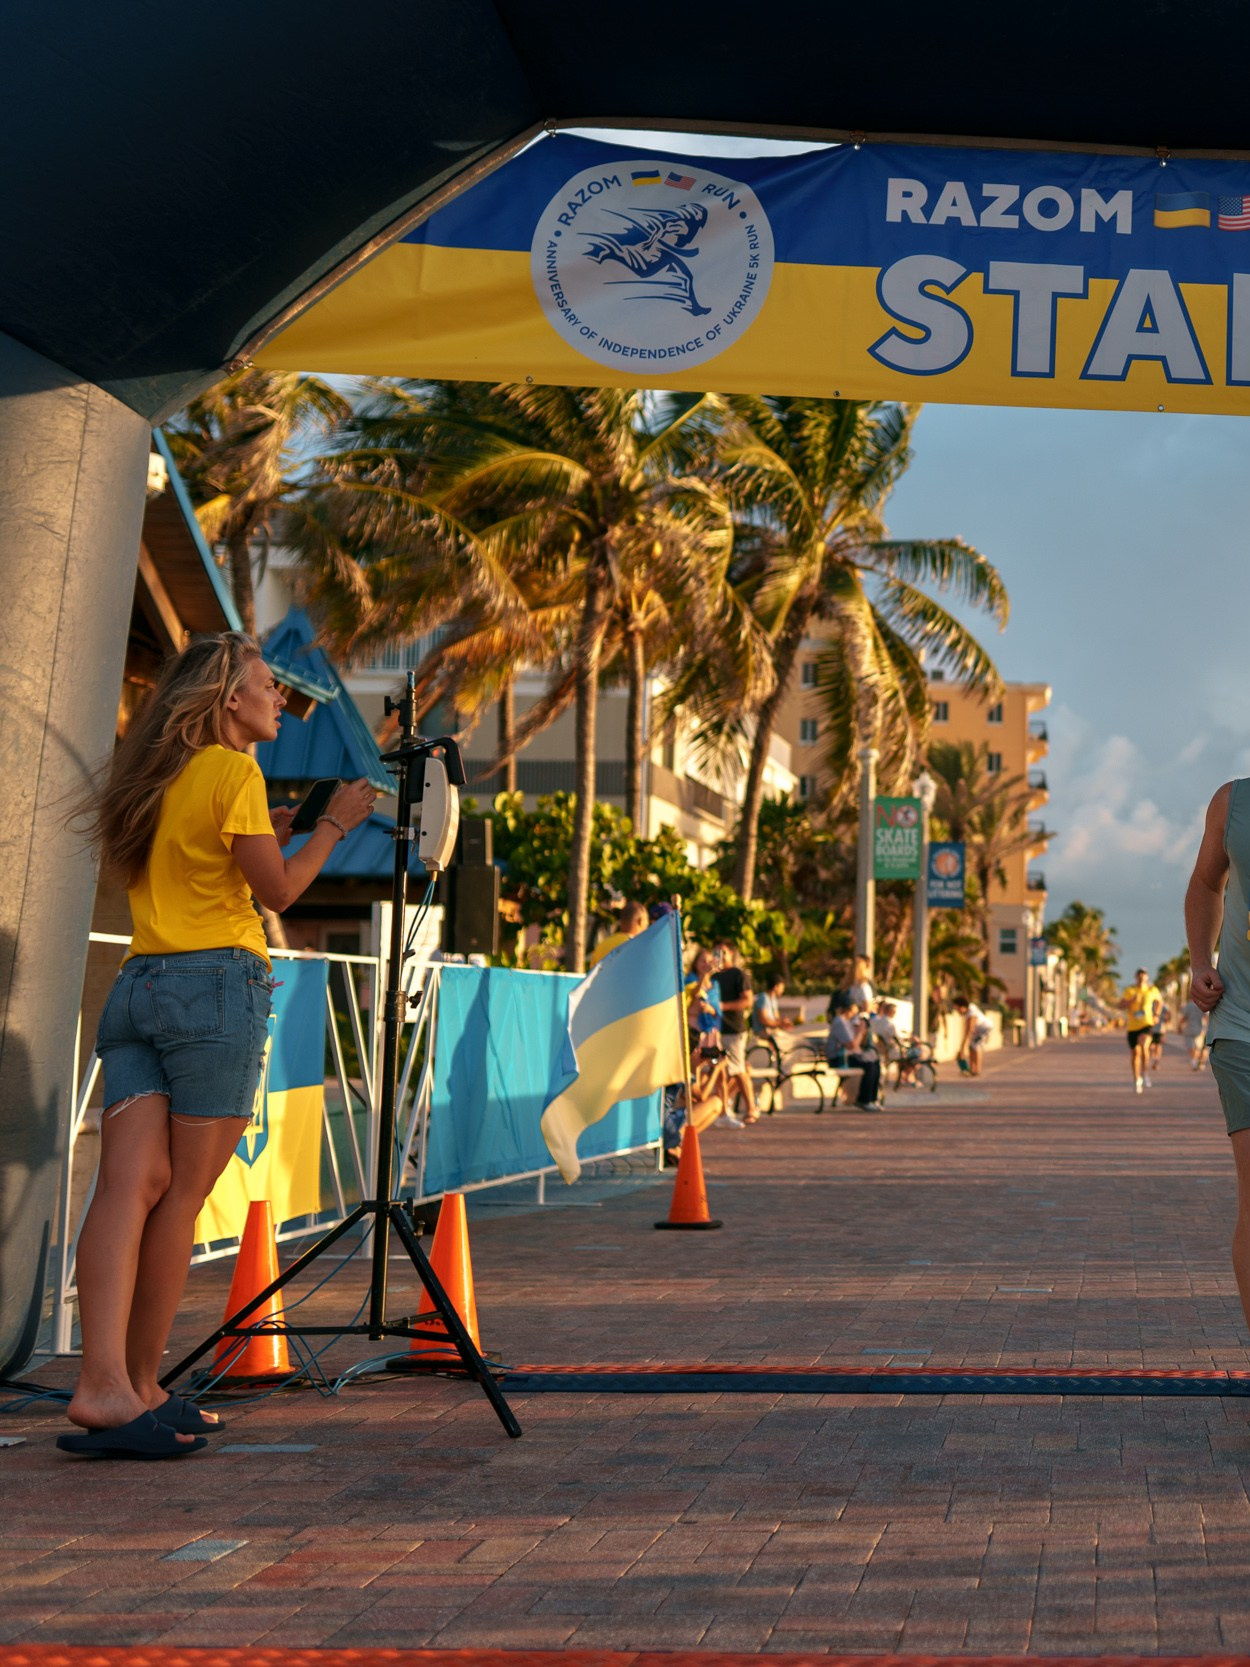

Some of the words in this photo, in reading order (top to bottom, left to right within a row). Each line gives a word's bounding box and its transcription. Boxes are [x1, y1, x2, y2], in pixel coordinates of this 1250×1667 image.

[557, 174, 622, 227] RAZOM
[701, 183, 741, 210] RUN
[885, 177, 1133, 235] RAZOM
[745, 224, 759, 250] RUN
[749, 253, 760, 268] 5K
[546, 240, 581, 327] ANNIVERSARY
[722, 272, 757, 325] UKRAINE
[580, 326, 598, 340] OF
[706, 324, 722, 340] OF
[598, 337, 704, 359] INDEPENDENCE
[876, 829, 918, 843] SKATE
[876, 843, 918, 856] BOARDS
